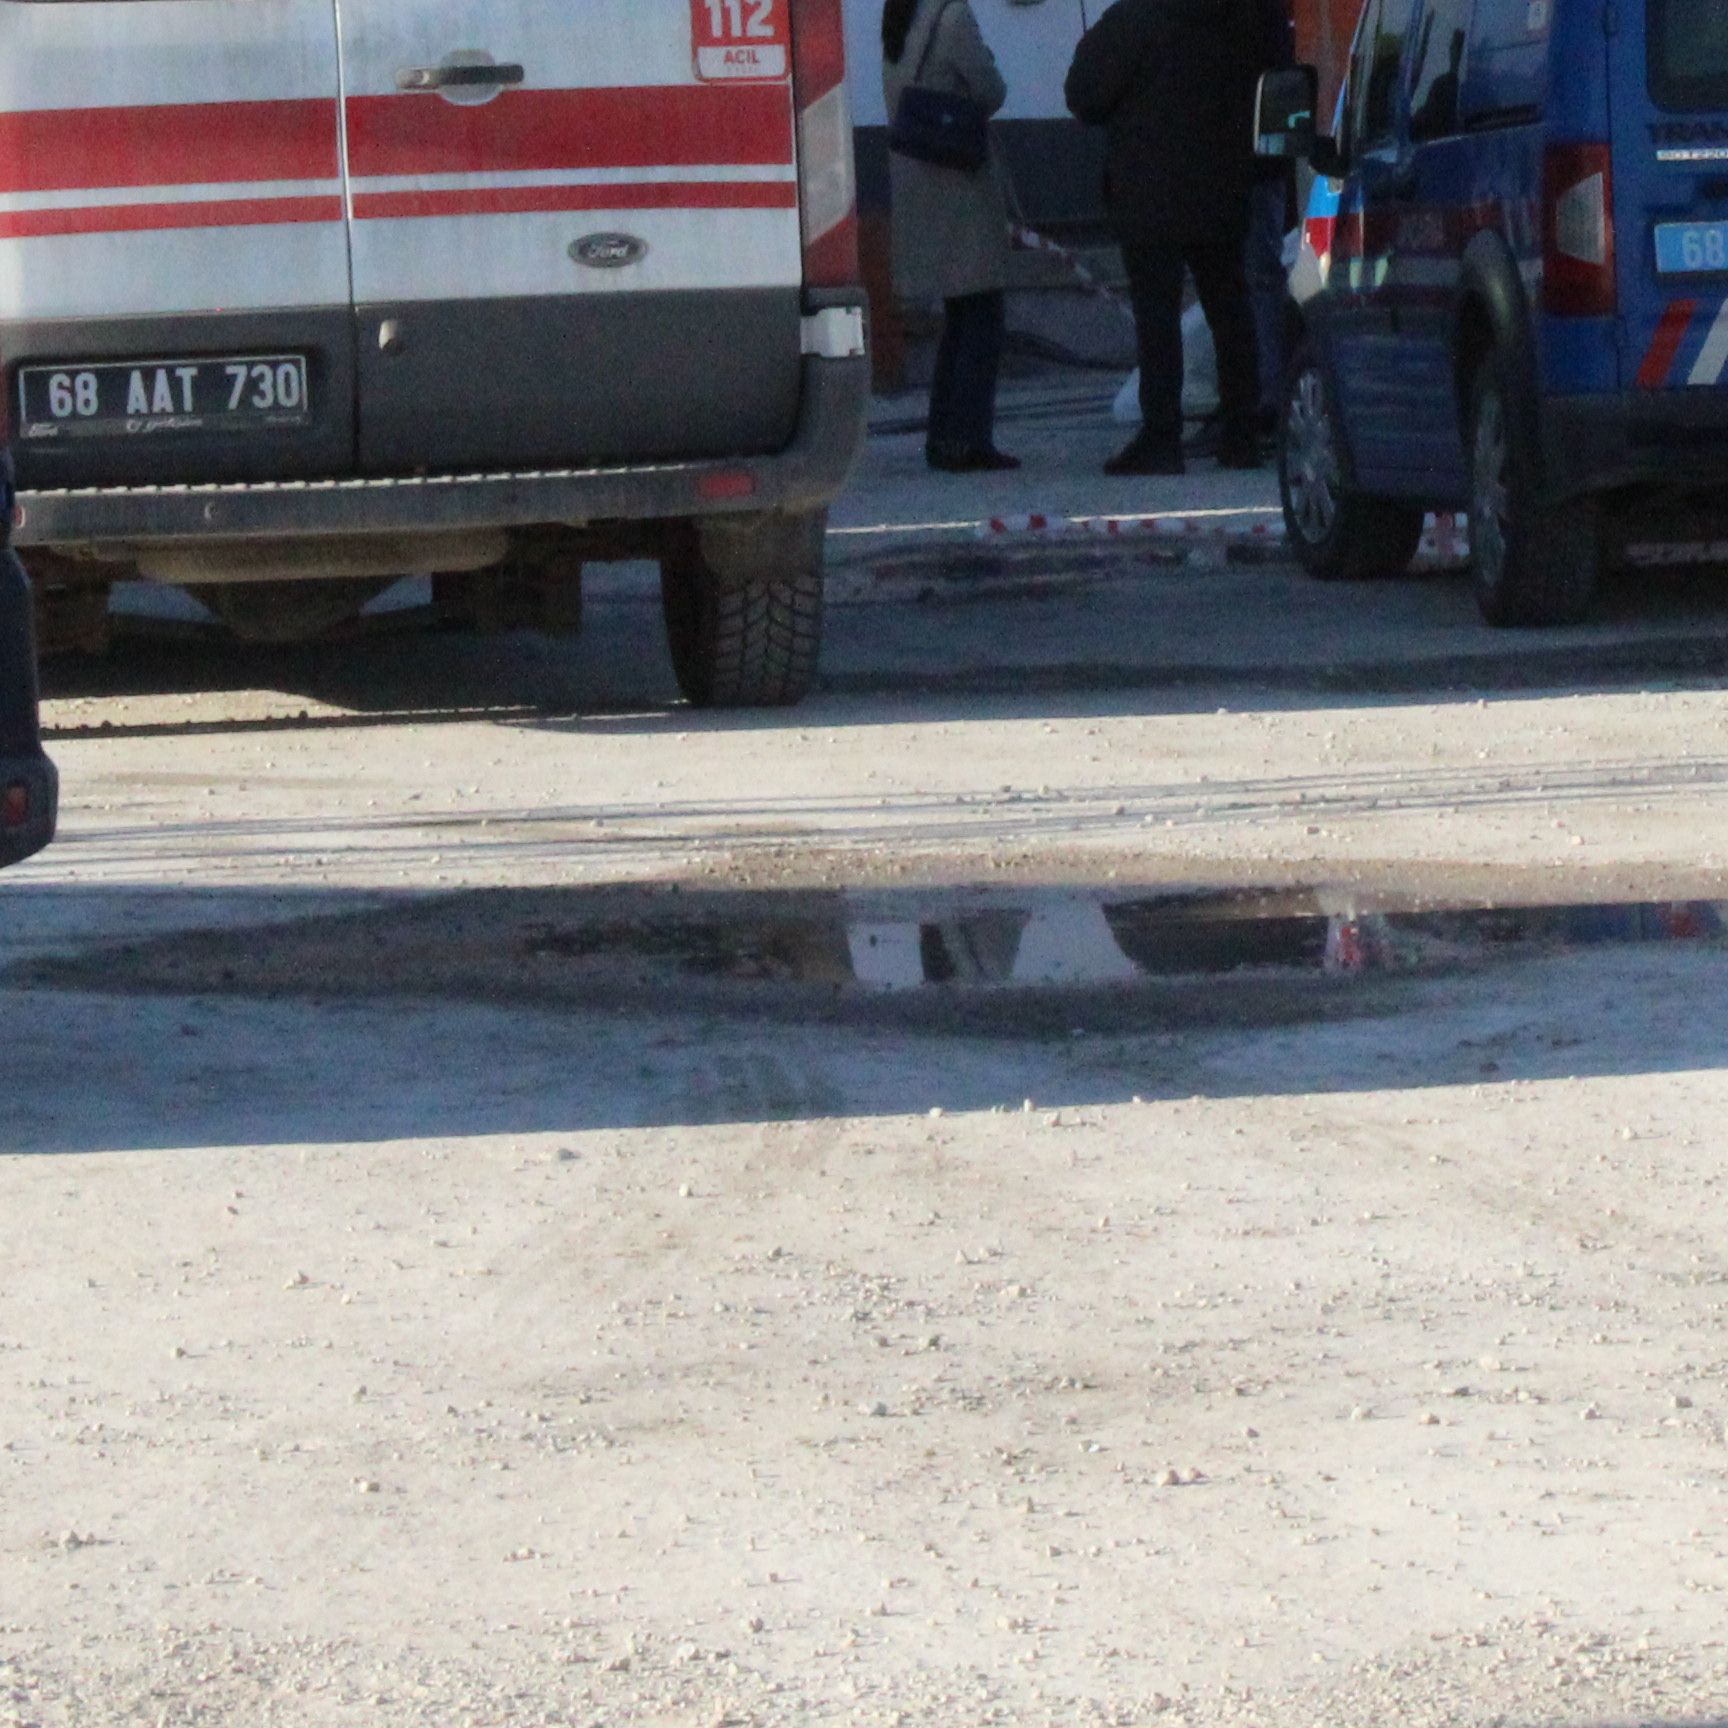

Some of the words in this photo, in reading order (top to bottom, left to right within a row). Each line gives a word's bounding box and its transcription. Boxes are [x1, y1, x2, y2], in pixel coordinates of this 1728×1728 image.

[1682, 229, 1725, 267] 68
[49, 372, 99, 418] 68
[126, 367, 198, 414] AAT
[225, 362, 301, 410] 730
